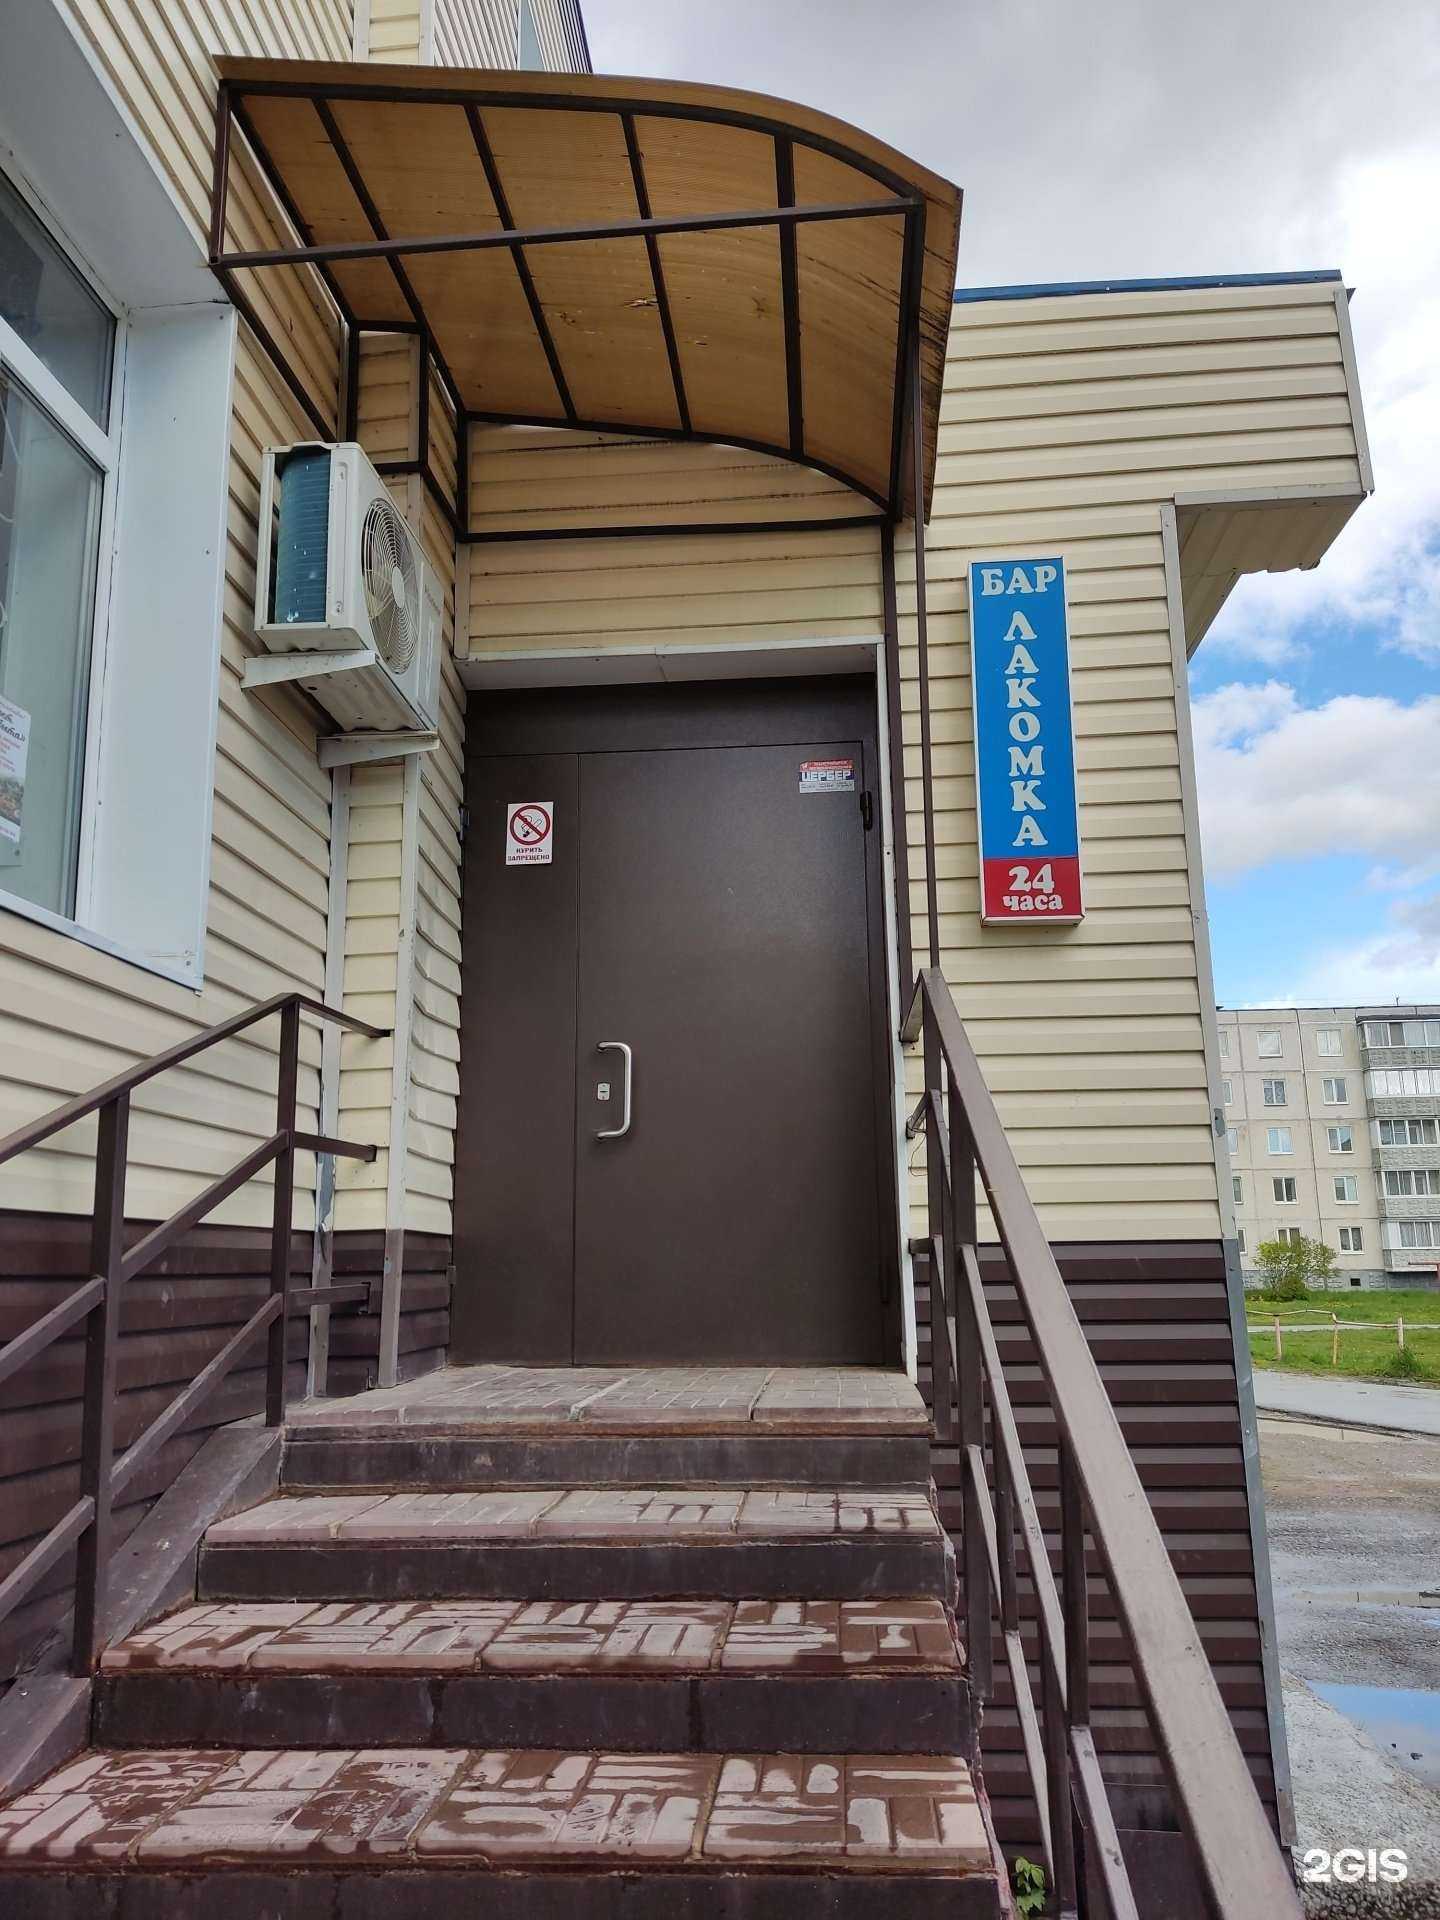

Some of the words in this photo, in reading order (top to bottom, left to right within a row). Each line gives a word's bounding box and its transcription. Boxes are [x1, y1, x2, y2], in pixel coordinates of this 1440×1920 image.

[981, 566, 1057, 596] БАР
[1003, 610, 1049, 847] ЛАКОМКА
[1008, 864, 1055, 894] 24
[1002, 894, 1063, 911] часа
